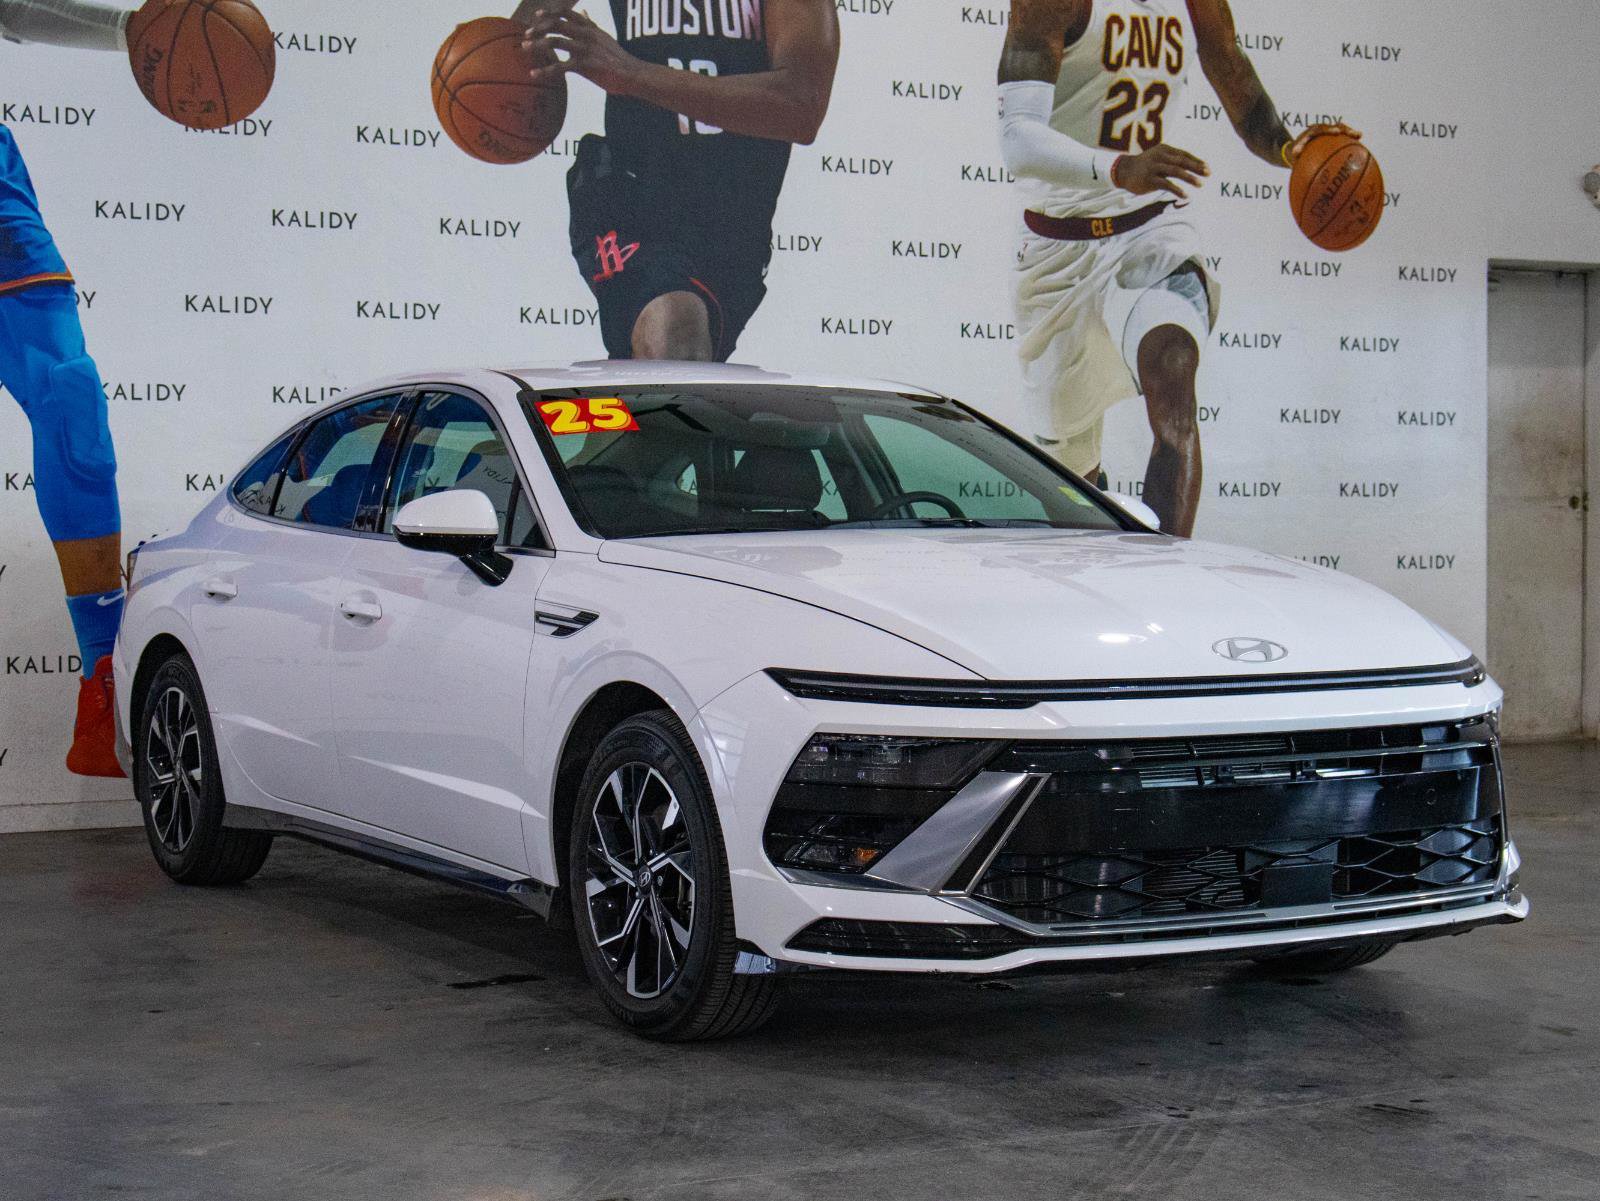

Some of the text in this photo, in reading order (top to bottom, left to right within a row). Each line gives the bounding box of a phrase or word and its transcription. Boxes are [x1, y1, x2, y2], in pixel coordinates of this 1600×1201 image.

[836, 0, 893, 15] ALIDY
[962, 8, 1010, 25] KALI
[272, 32, 357, 54] KALIDY
[1102, 12, 1184, 76] CAVS
[1235, 34, 1283, 51] ALIDY
[1342, 43, 1400, 61] KALIDY
[892, 81, 962, 101] KALIDY
[3, 104, 95, 126] KALIDY
[1098, 78, 1170, 153] 23
[357, 126, 440, 147] KALIDY
[1400, 121, 1457, 139] KALIDY
[822, 156, 893, 175] KALIDY
[1221, 182, 1282, 199] KALIDY
[95, 201, 185, 221] KALIDY
[272, 209, 357, 229] KALIDY
[440, 218, 520, 237] KALIDY
[1091, 216, 1114, 237] CLE
[770, 235, 822, 252] LIDY
[892, 240, 962, 258] KALIDY
[1281, 260, 1341, 277] KALIDY
[1399, 266, 1456, 283] KALIDY
[185, 294, 272, 314] KALIDY
[357, 301, 440, 320] KALIDY
[520, 307, 599, 326] KALIDY
[821, 317, 892, 335] KALIDY
[961, 323, 1014, 340] KALID
[1220, 332, 1281, 348] KALIDY
[1340, 337, 1399, 353] KALIDY
[273, 386, 347, 404] KALI
[540, 398, 632, 433] 25
[1280, 409, 1341, 424] KALIDY
[1398, 411, 1456, 426] KALIDY
[1219, 482, 1280, 497] KALIDY
[1340, 483, 1398, 498] KALIDY
[1397, 555, 1455, 570] KALIDY
[7, 655, 82, 675] KALID
